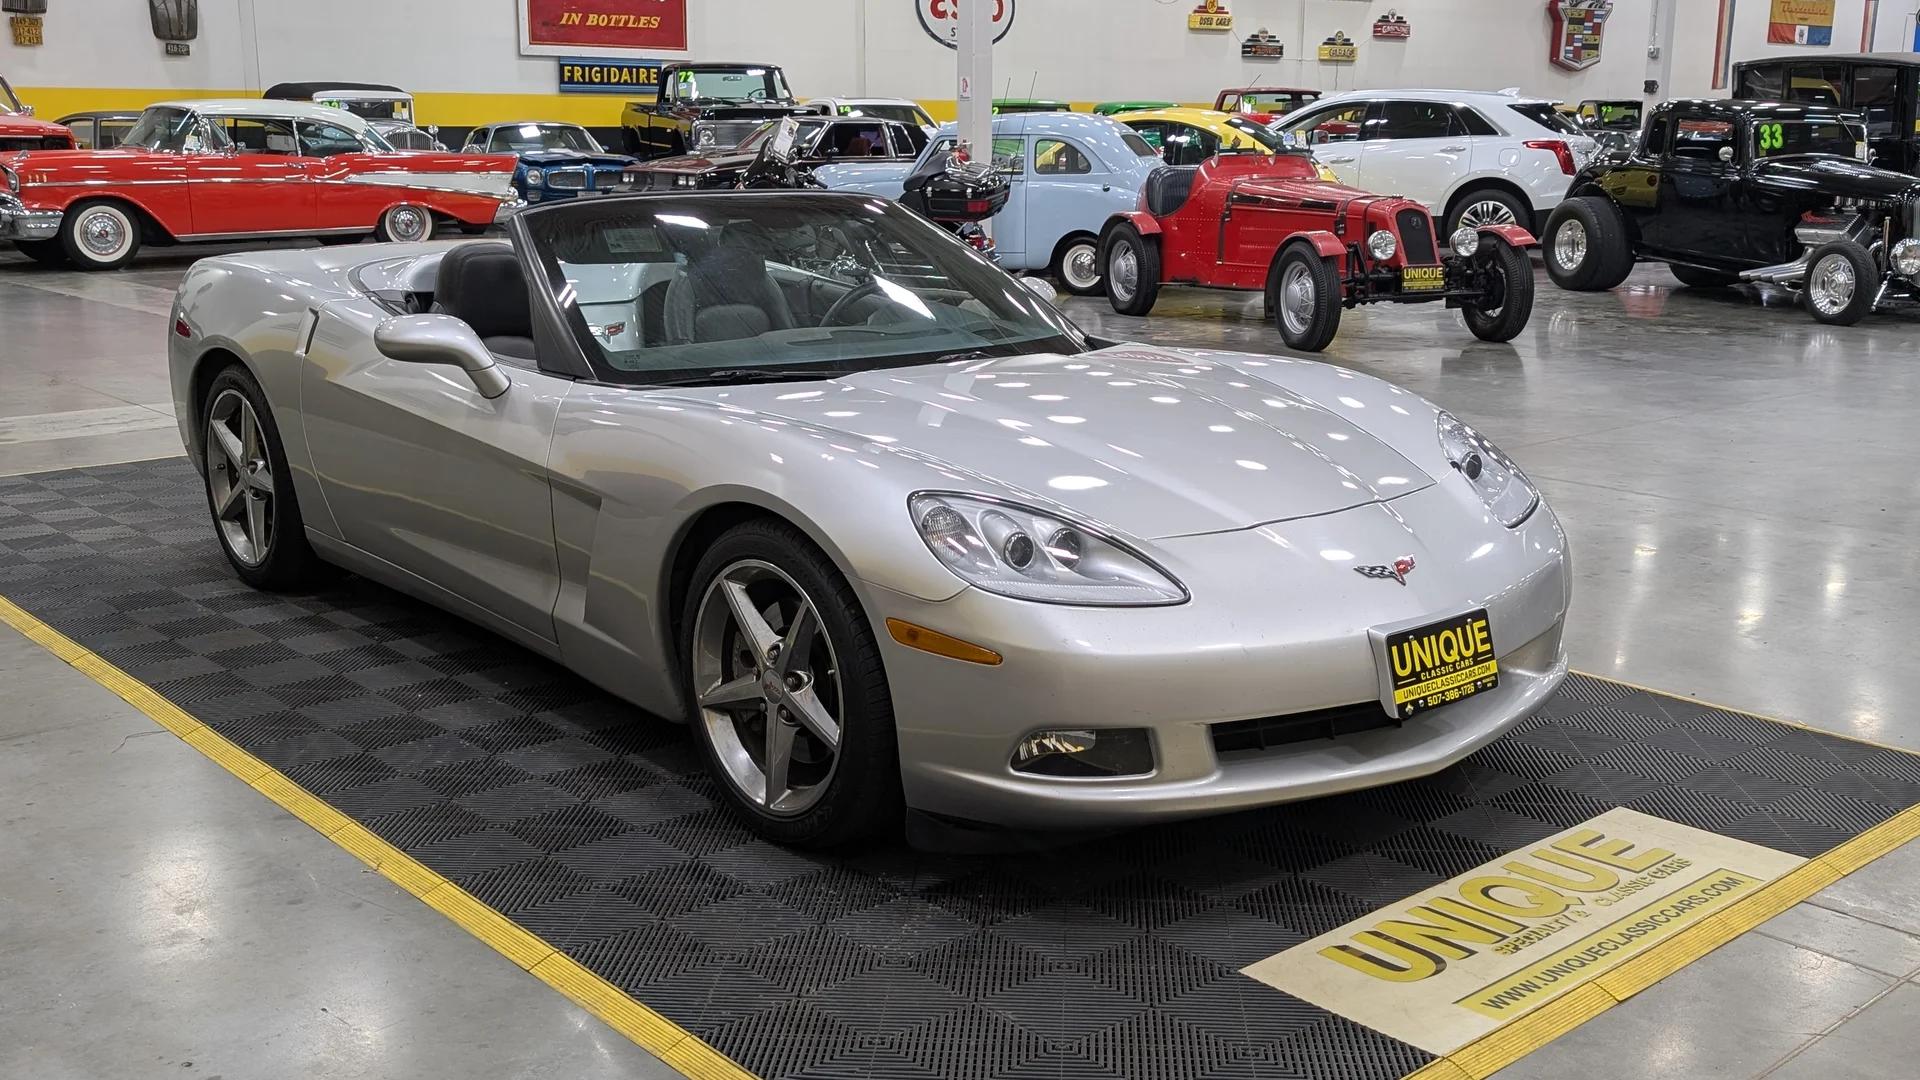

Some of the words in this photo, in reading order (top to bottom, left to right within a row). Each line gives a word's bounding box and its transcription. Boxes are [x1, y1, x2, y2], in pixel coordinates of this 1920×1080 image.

[560, 12, 582, 25] IN
[586, 13, 661, 28] BOTTLES
[563, 66, 658, 84] FRIGIDAIRE
[679, 71, 695, 83] 72
[1759, 123, 1784, 149] 33
[1403, 267, 1443, 279] UNIQUE
[1391, 619, 1491, 677] UNIQUE
[1403, 664, 1491, 699] UNIQUECLASSICCARS.COM
[1421, 666, 1454, 680] CLASSIC
[1456, 658, 1474, 670] CARS
[1317, 829, 1676, 983] UNIQUE
[1493, 914, 1577, 955] SPECIALTY
[1594, 874, 1653, 907] CLASSIC
[1648, 857, 1692, 879] CARS
[1481, 876, 1746, 1010] WWW.UNIQUECLASSICCARS.COM
